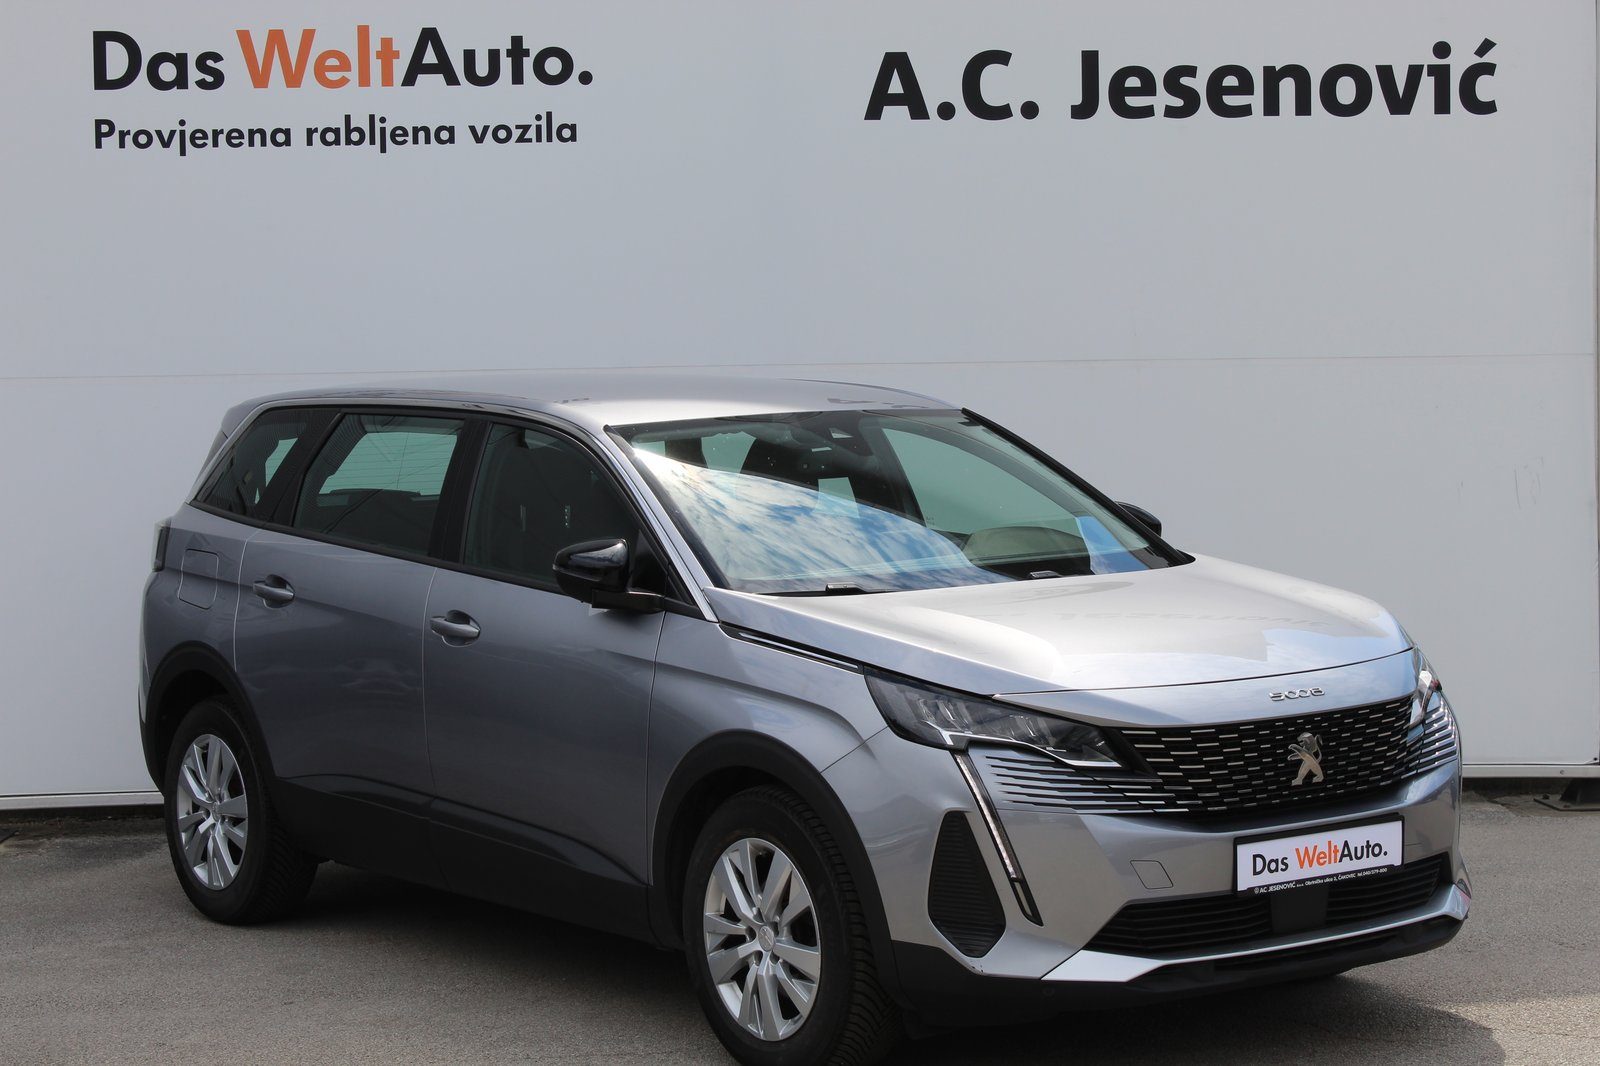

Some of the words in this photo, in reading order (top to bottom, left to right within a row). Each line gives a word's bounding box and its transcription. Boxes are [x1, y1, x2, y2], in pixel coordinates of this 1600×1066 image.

[92, 30, 225, 92] Das
[235, 24, 595, 90] WeltAuto.
[863, 49, 1040, 121] A.C.
[1070, 37, 1498, 120] Jesenović
[94, 118, 292, 157] Provjerena
[306, 113, 456, 154] rabljena
[467, 110, 578, 145] vozila
[1269, 687, 1325, 701] 5008
[1252, 853, 1289, 876] Das
[1295, 840, 1388, 869] WeltAuto.
